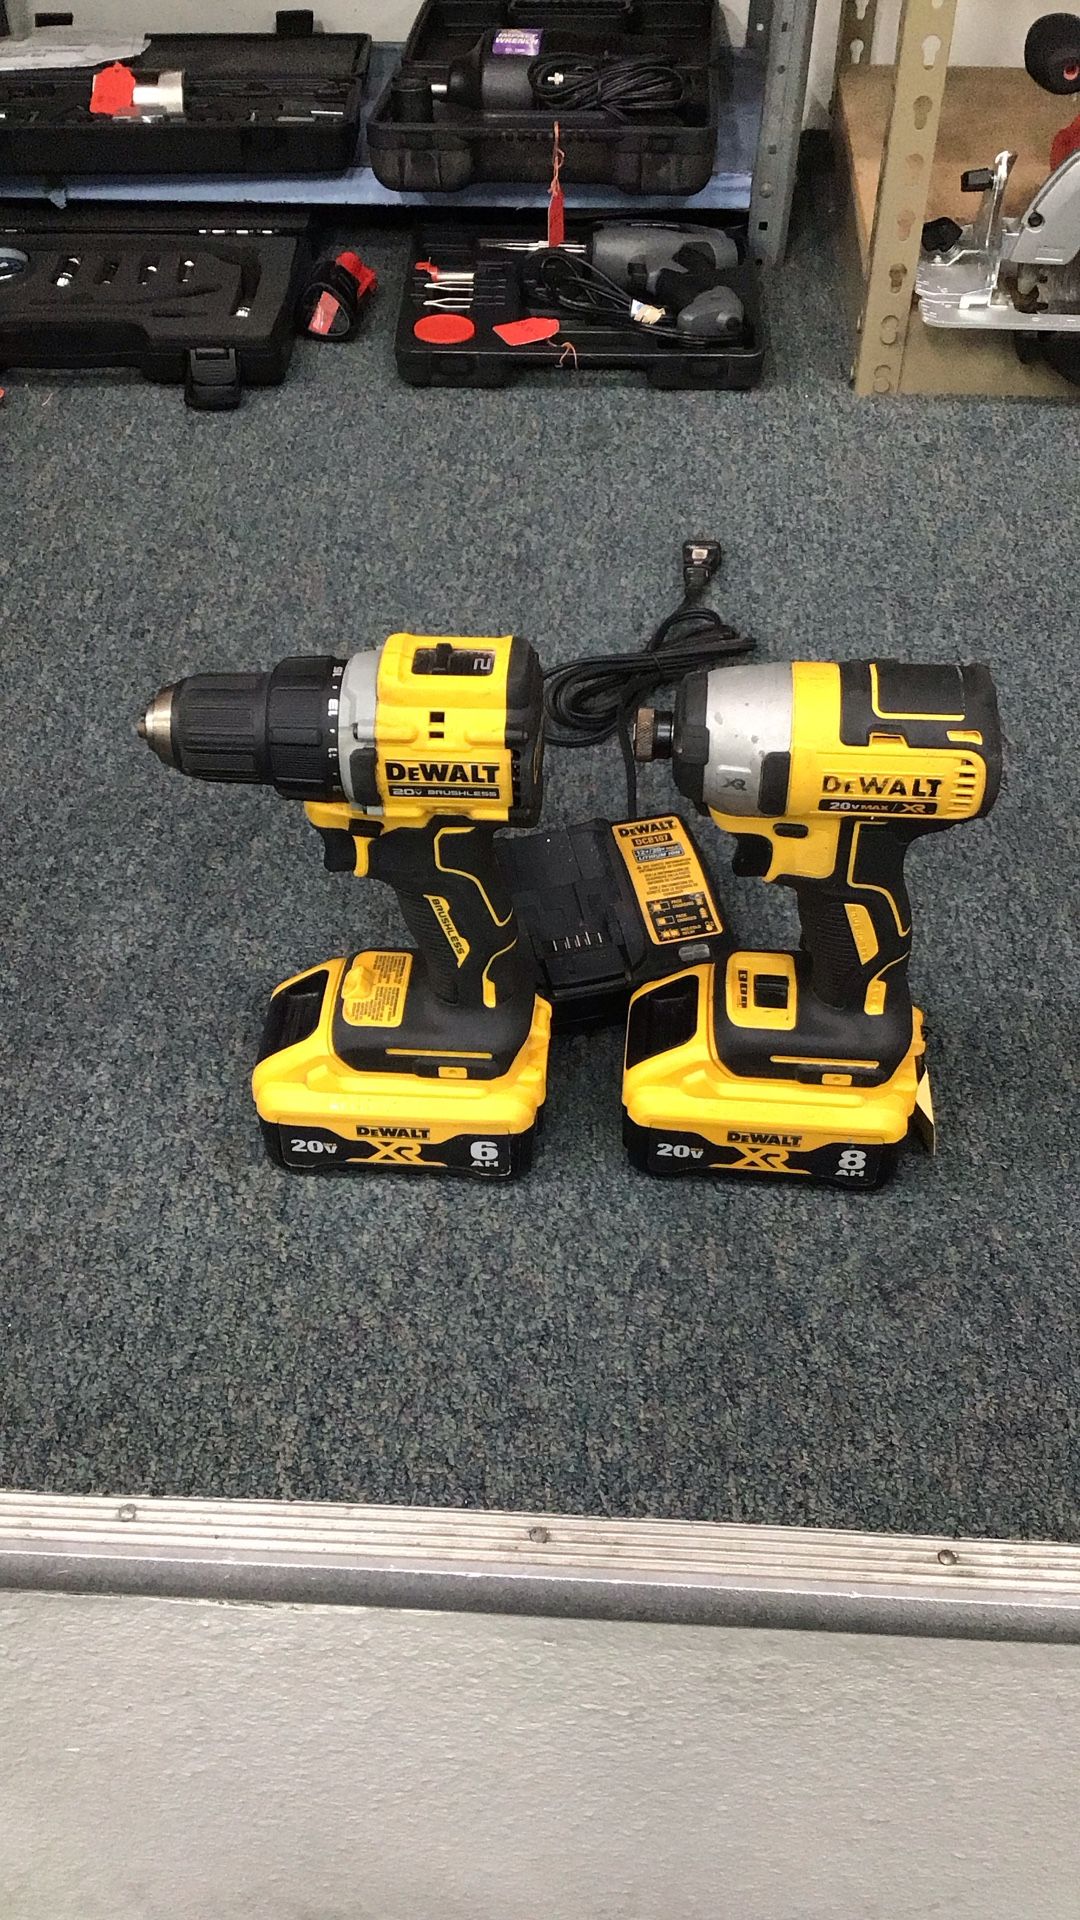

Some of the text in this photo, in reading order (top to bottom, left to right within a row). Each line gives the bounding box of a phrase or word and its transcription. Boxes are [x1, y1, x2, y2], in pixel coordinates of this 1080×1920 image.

[427, 789, 498, 797] BRUSHLESS
[635, 834, 669, 846] DCB107
[431, 898, 465, 955] BRUSHLESS
[366, 1141, 423, 1164] XR
[469, 1140, 498, 1161] 6
[730, 1147, 790, 1170] XR
[838, 1150, 866, 1169] 8
